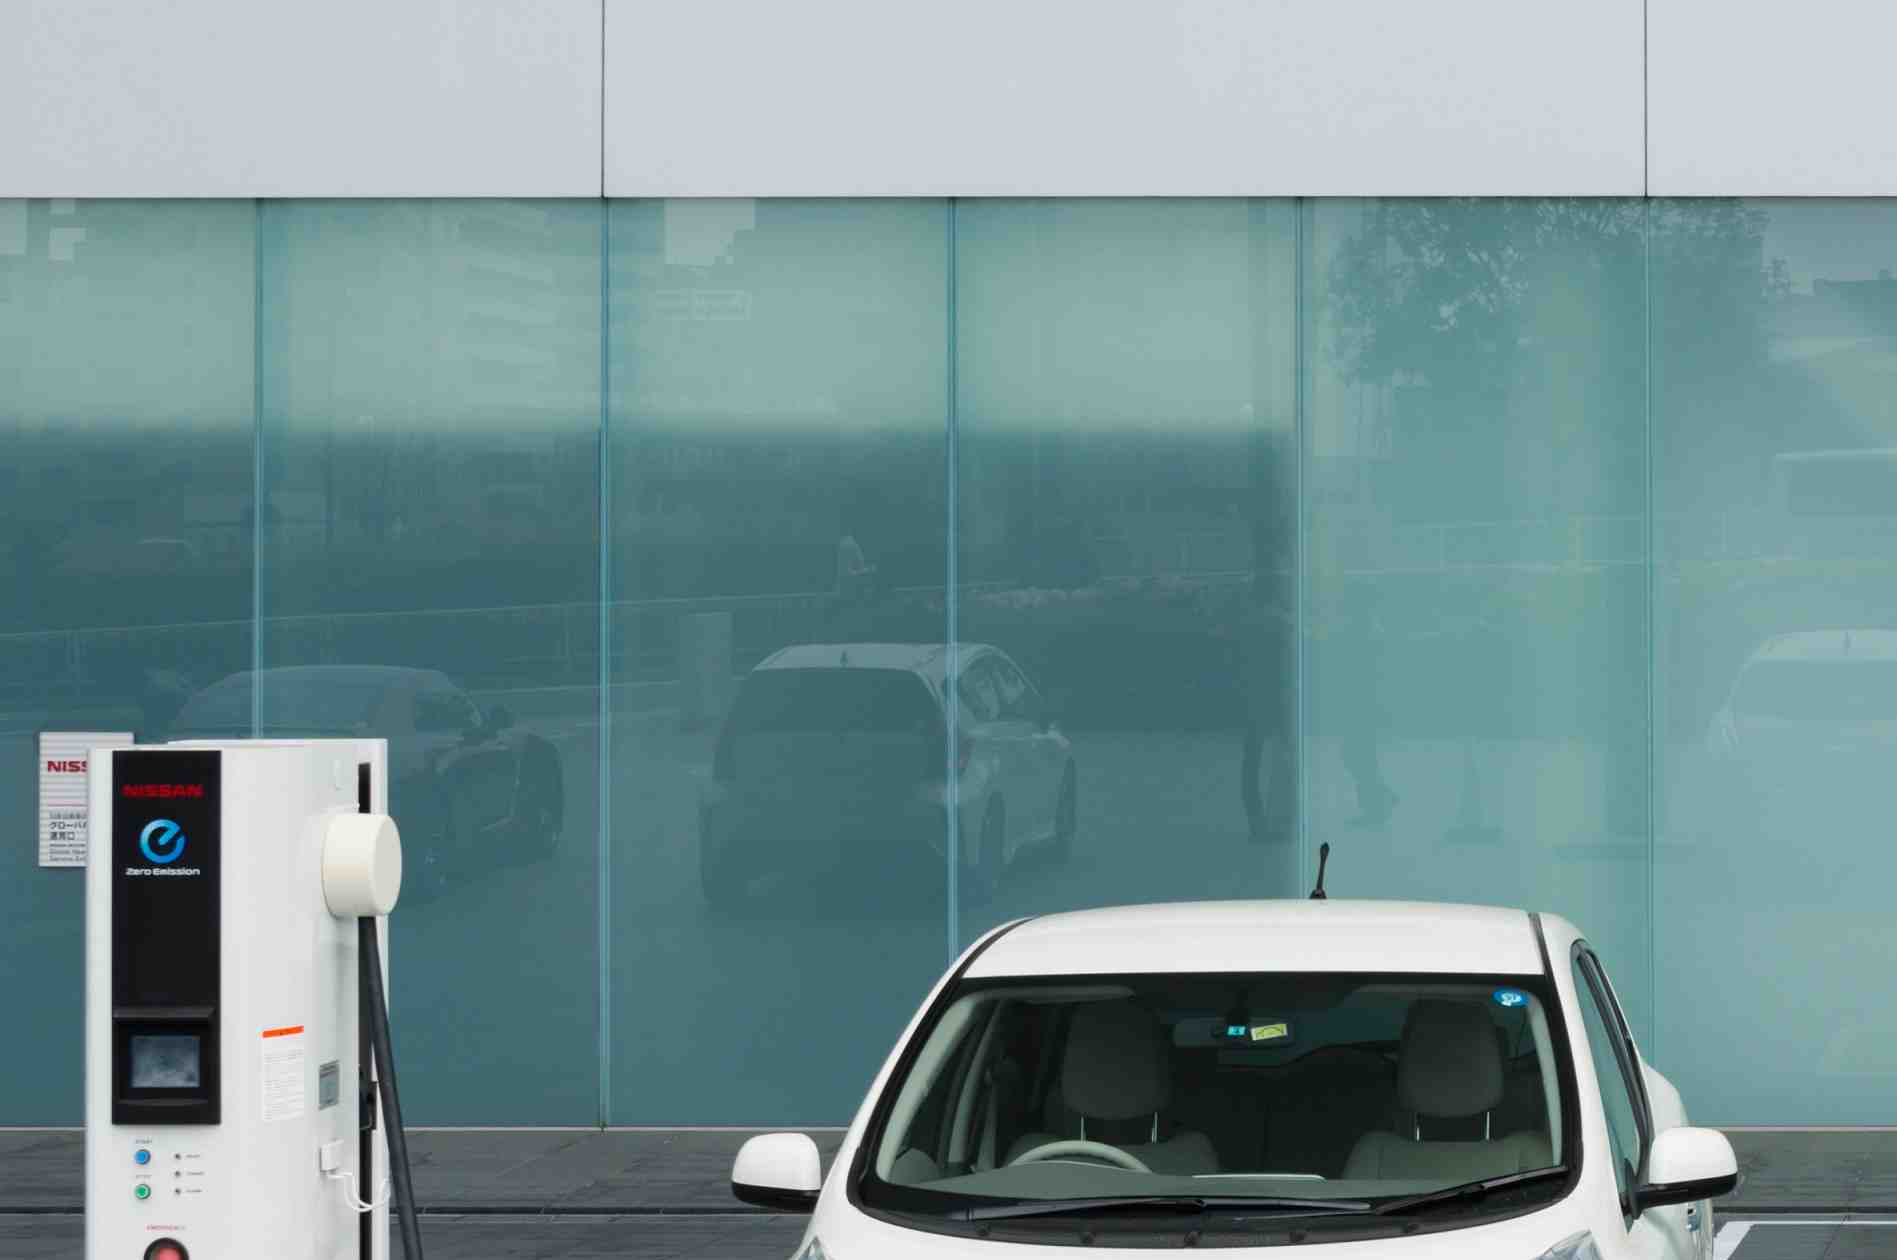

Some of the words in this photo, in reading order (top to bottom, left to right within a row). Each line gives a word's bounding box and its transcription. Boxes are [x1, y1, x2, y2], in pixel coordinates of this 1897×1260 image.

[122, 783, 204, 798] NISSAN
[125, 867, 152, 876] Zero
[152, 866, 201, 876] Emission
